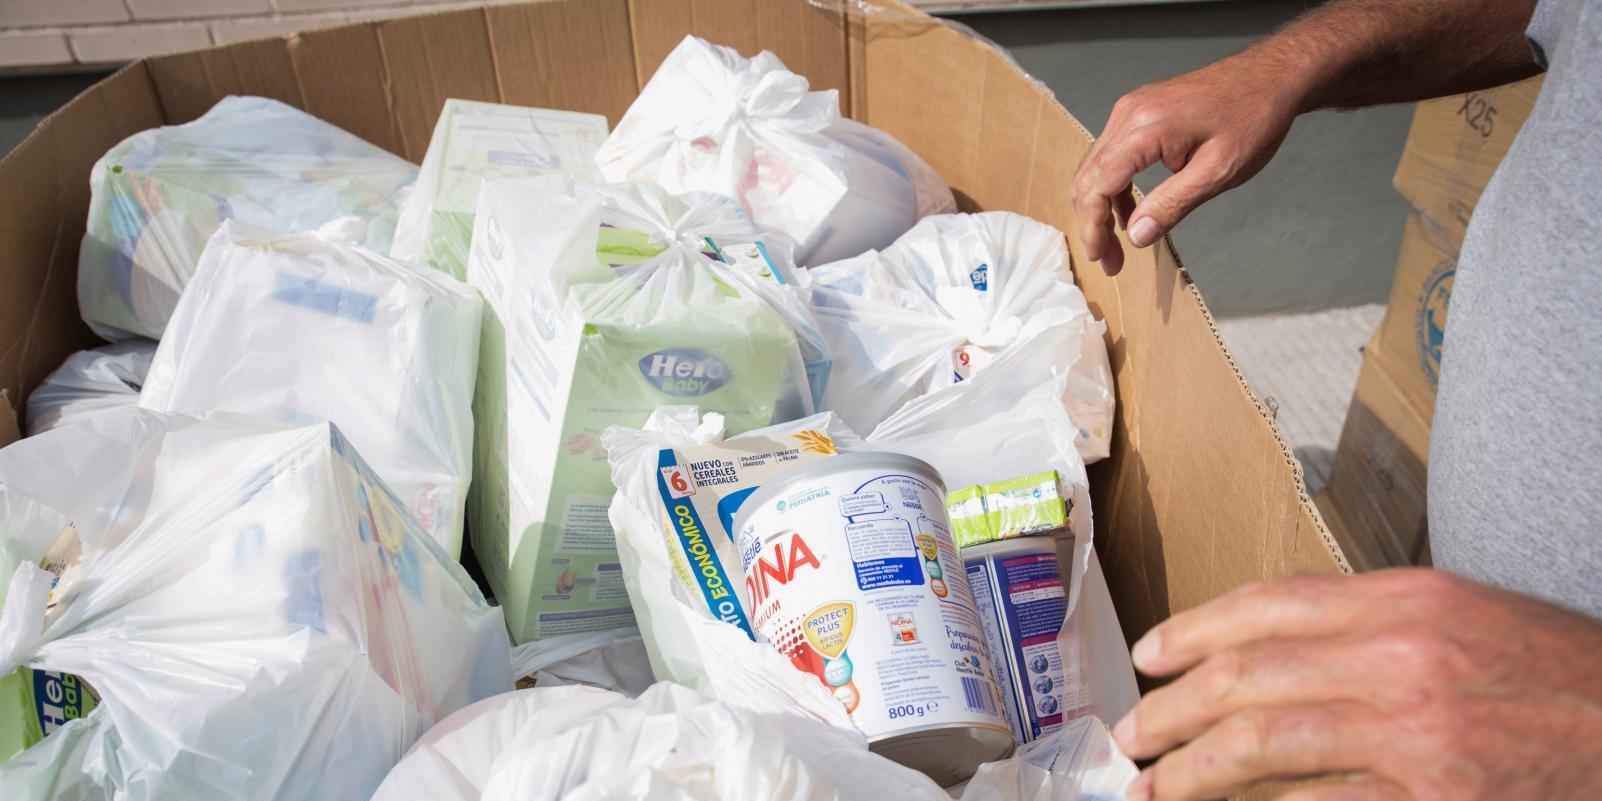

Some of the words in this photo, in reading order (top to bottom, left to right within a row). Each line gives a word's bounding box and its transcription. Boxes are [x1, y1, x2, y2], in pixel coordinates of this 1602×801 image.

[648, 354, 722, 380] Hero
[662, 378, 710, 395] Baby
[690, 459, 722, 472] NUEVO
[693, 467, 736, 480] CEREALES
[671, 471, 687, 492] 6
[696, 475, 739, 488] INTEGRALES
[675, 505, 729, 600] ECONÓMICO
[743, 537, 762, 573] estlé
[746, 533, 820, 621] DINA
[808, 608, 849, 628] PROTECT
[818, 621, 840, 635] PLUS
[63, 672, 78, 720] Bab
[889, 704, 915, 719] 800
[917, 706, 925, 717] g
